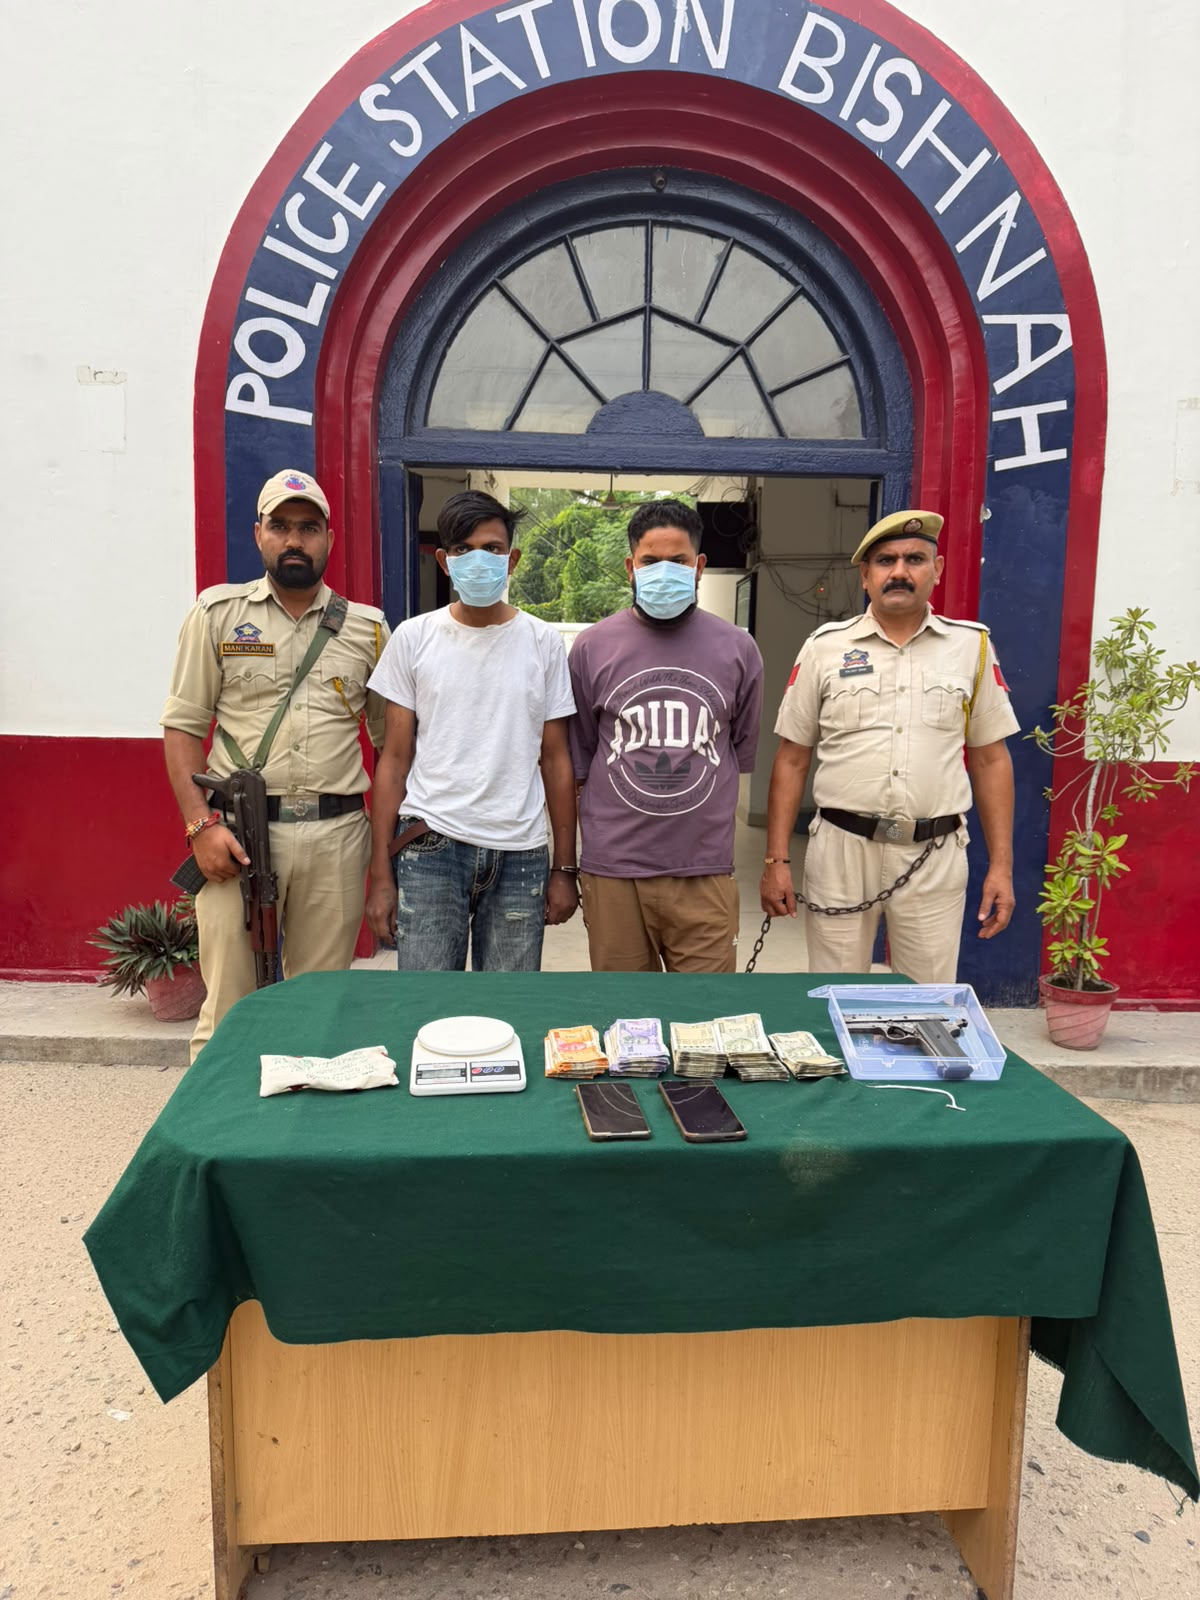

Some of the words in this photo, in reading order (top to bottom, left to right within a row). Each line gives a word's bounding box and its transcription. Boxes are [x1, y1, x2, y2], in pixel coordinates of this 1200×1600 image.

[225, 142, 386, 426] POLICE
[360, 0, 735, 157] STATION
[778, 12, 1073, 471] BISHNAH
